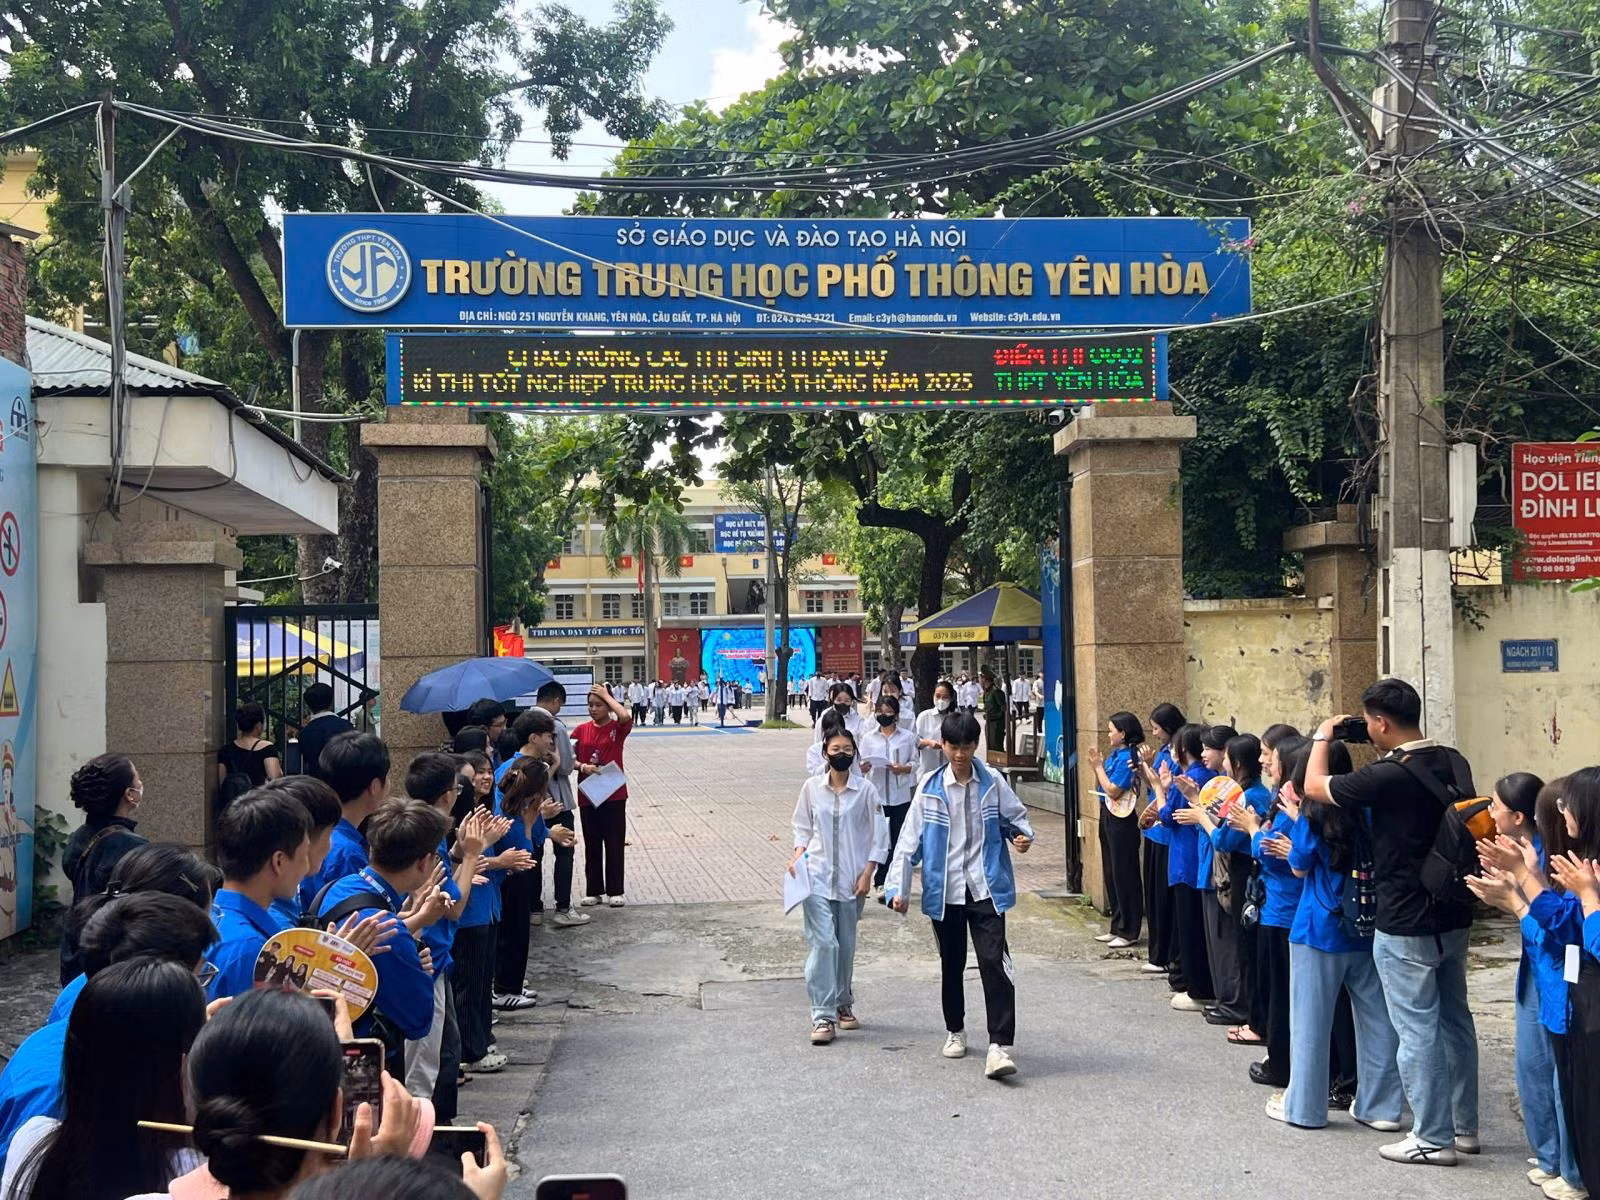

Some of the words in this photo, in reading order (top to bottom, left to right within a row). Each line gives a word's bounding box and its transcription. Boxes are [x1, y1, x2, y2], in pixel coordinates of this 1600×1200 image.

[616, 222, 646, 245] SỞ
[652, 222, 707, 246] GIÁO
[714, 229, 756, 251] DỤC
[764, 224, 790, 247] VÀ
[795, 223, 840, 247] ĐÀO
[847, 230, 887, 252] TẠO
[894, 224, 922, 247] HÀ
[930, 225, 966, 252] NỘI
[420, 250, 582, 296] TRƯỜNG
[592, 262, 724, 298] TRUNG
[731, 263, 809, 305] HỌC
[817, 250, 898, 298] PHỔ
[904, 255, 1033, 297] THÔNG
[1043, 255, 1121, 296] YÊN
[1130, 252, 1209, 296] HÒA
[459, 311, 476, 323] ĐỊA
[519, 311, 536, 322] 251
[537, 308, 574, 322] NGUYỄN
[576, 311, 609, 323] KHANG,
[611, 309, 628, 323] YÊN
[652, 310, 672, 323] CẦU
[695, 312, 709, 323] TP.
[711, 310, 724, 323] HÀ
[725, 311, 741, 326] NỘI
[848, 312, 875, 323] Email:
[970, 312, 1007, 322] Website:
[1007, 312, 1061, 324] c3yh.edu.vn
[437, 373, 473, 393] THI
[478, 368, 522, 393] TỐT
[527, 374, 607, 396] NGHIỆP
[610, 374, 686, 393] TRUNG
[691, 374, 738, 396] HỌC
[742, 369, 787, 393] PHỔ
[791, 369, 867, 393] THÔNG
[872, 372, 920, 393] NĂM
[924, 373, 973, 392] 2025
[993, 372, 1049, 390] THPT
[1051, 366, 1092, 390] YÊN
[1097, 366, 1145, 390] HÒA
[1522, 453, 1546, 465] Học
[1547, 453, 1572, 465] viện
[1521, 471, 1570, 492] DOL
[1520, 493, 1577, 518] ĐÌNH
[567, 629, 584, 638] DẠY
[587, 626, 603, 636] TỐT
[611, 628, 628, 637] HỌC
